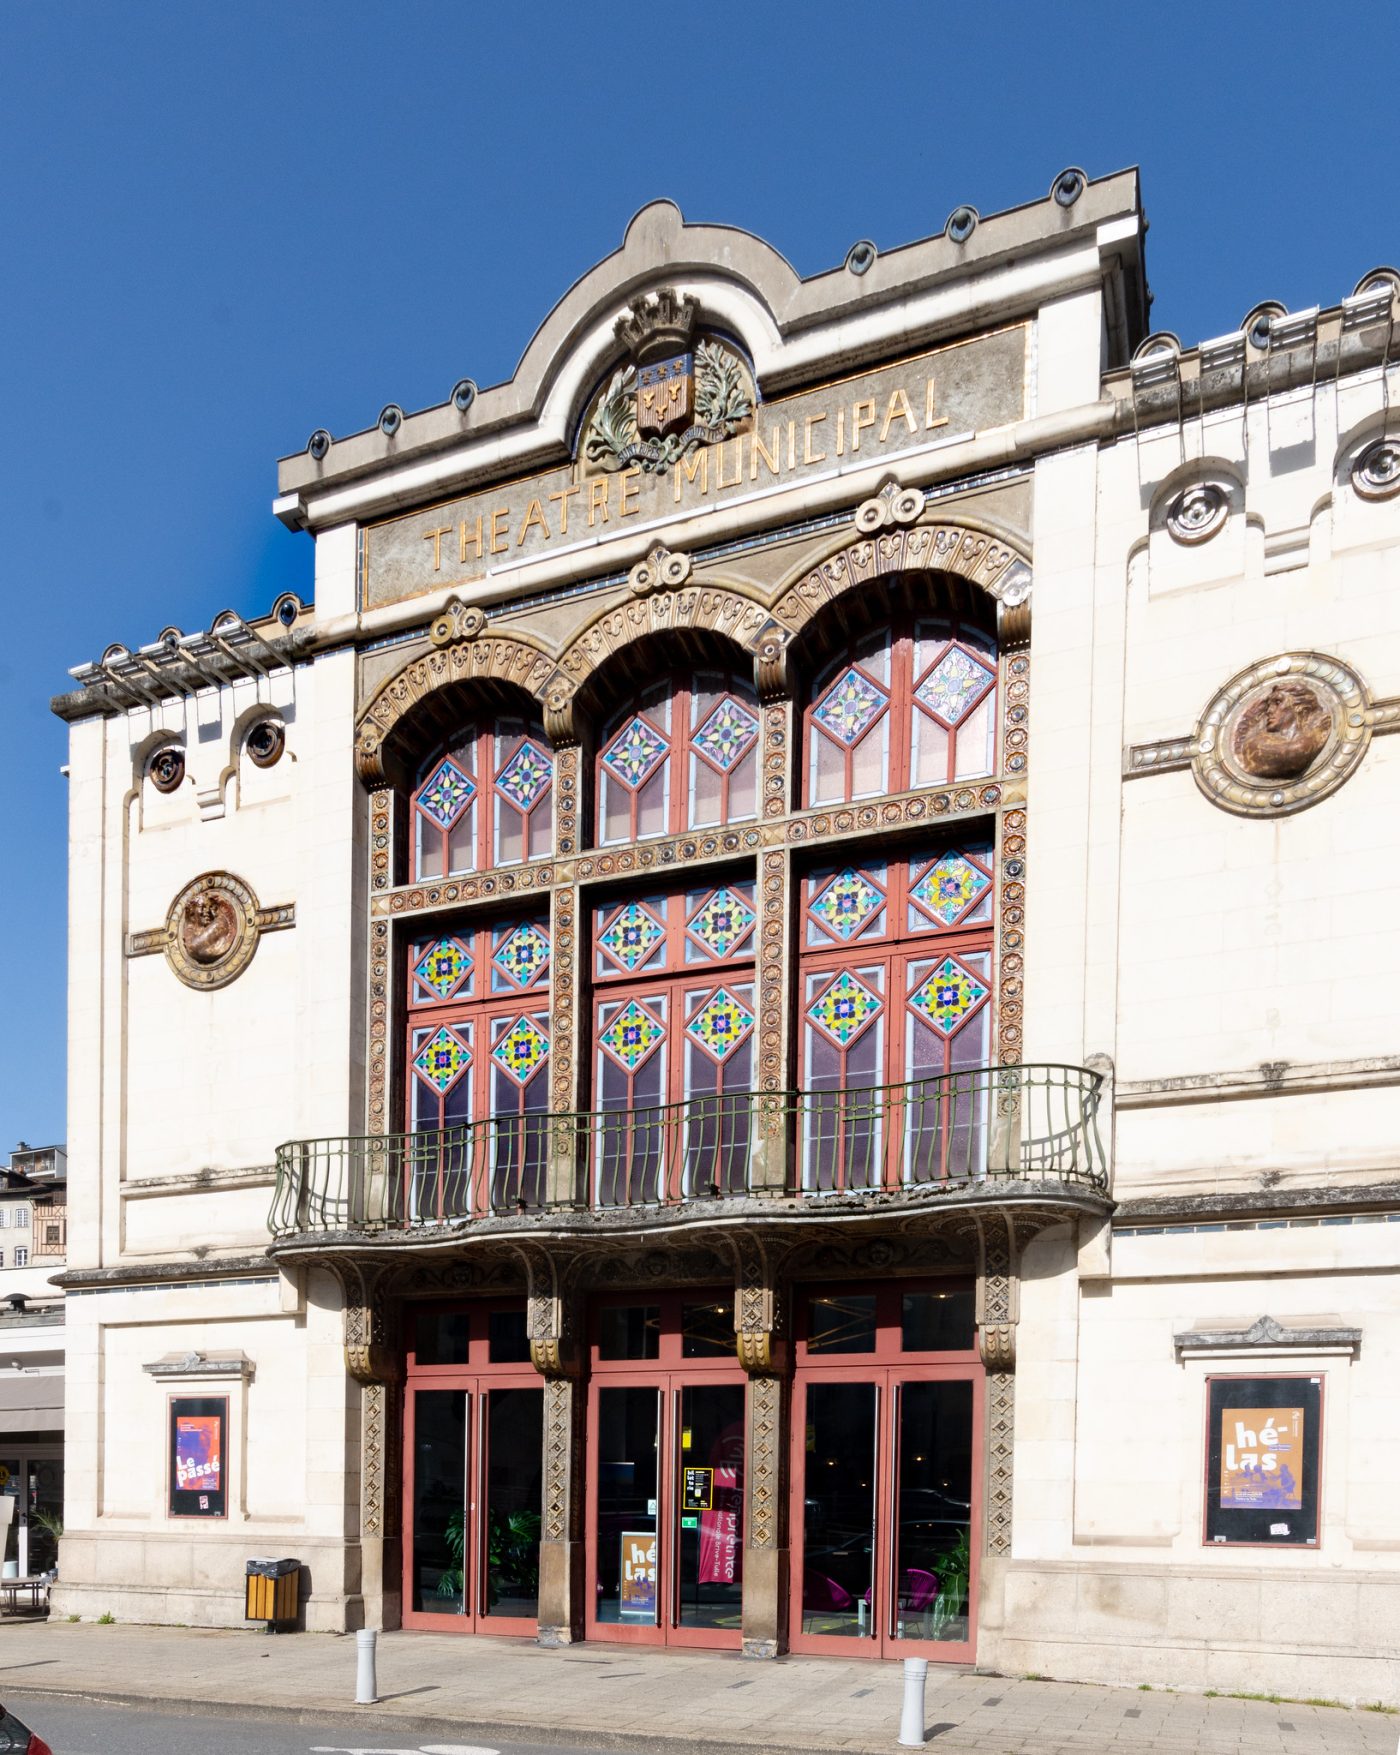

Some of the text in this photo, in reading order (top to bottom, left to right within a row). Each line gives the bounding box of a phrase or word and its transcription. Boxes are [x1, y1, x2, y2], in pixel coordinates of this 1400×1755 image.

[424, 378, 949, 570] THEATRE MUNICIPAL
[1235, 1417, 1288, 1449] hé-
[176, 1455, 196, 1471] Le
[178, 1455, 220, 1487] passé
[1226, 1444, 1277, 1471] las
[625, 1560, 656, 1582] las
[713, 1541, 722, 1577] Brive-Tulle
